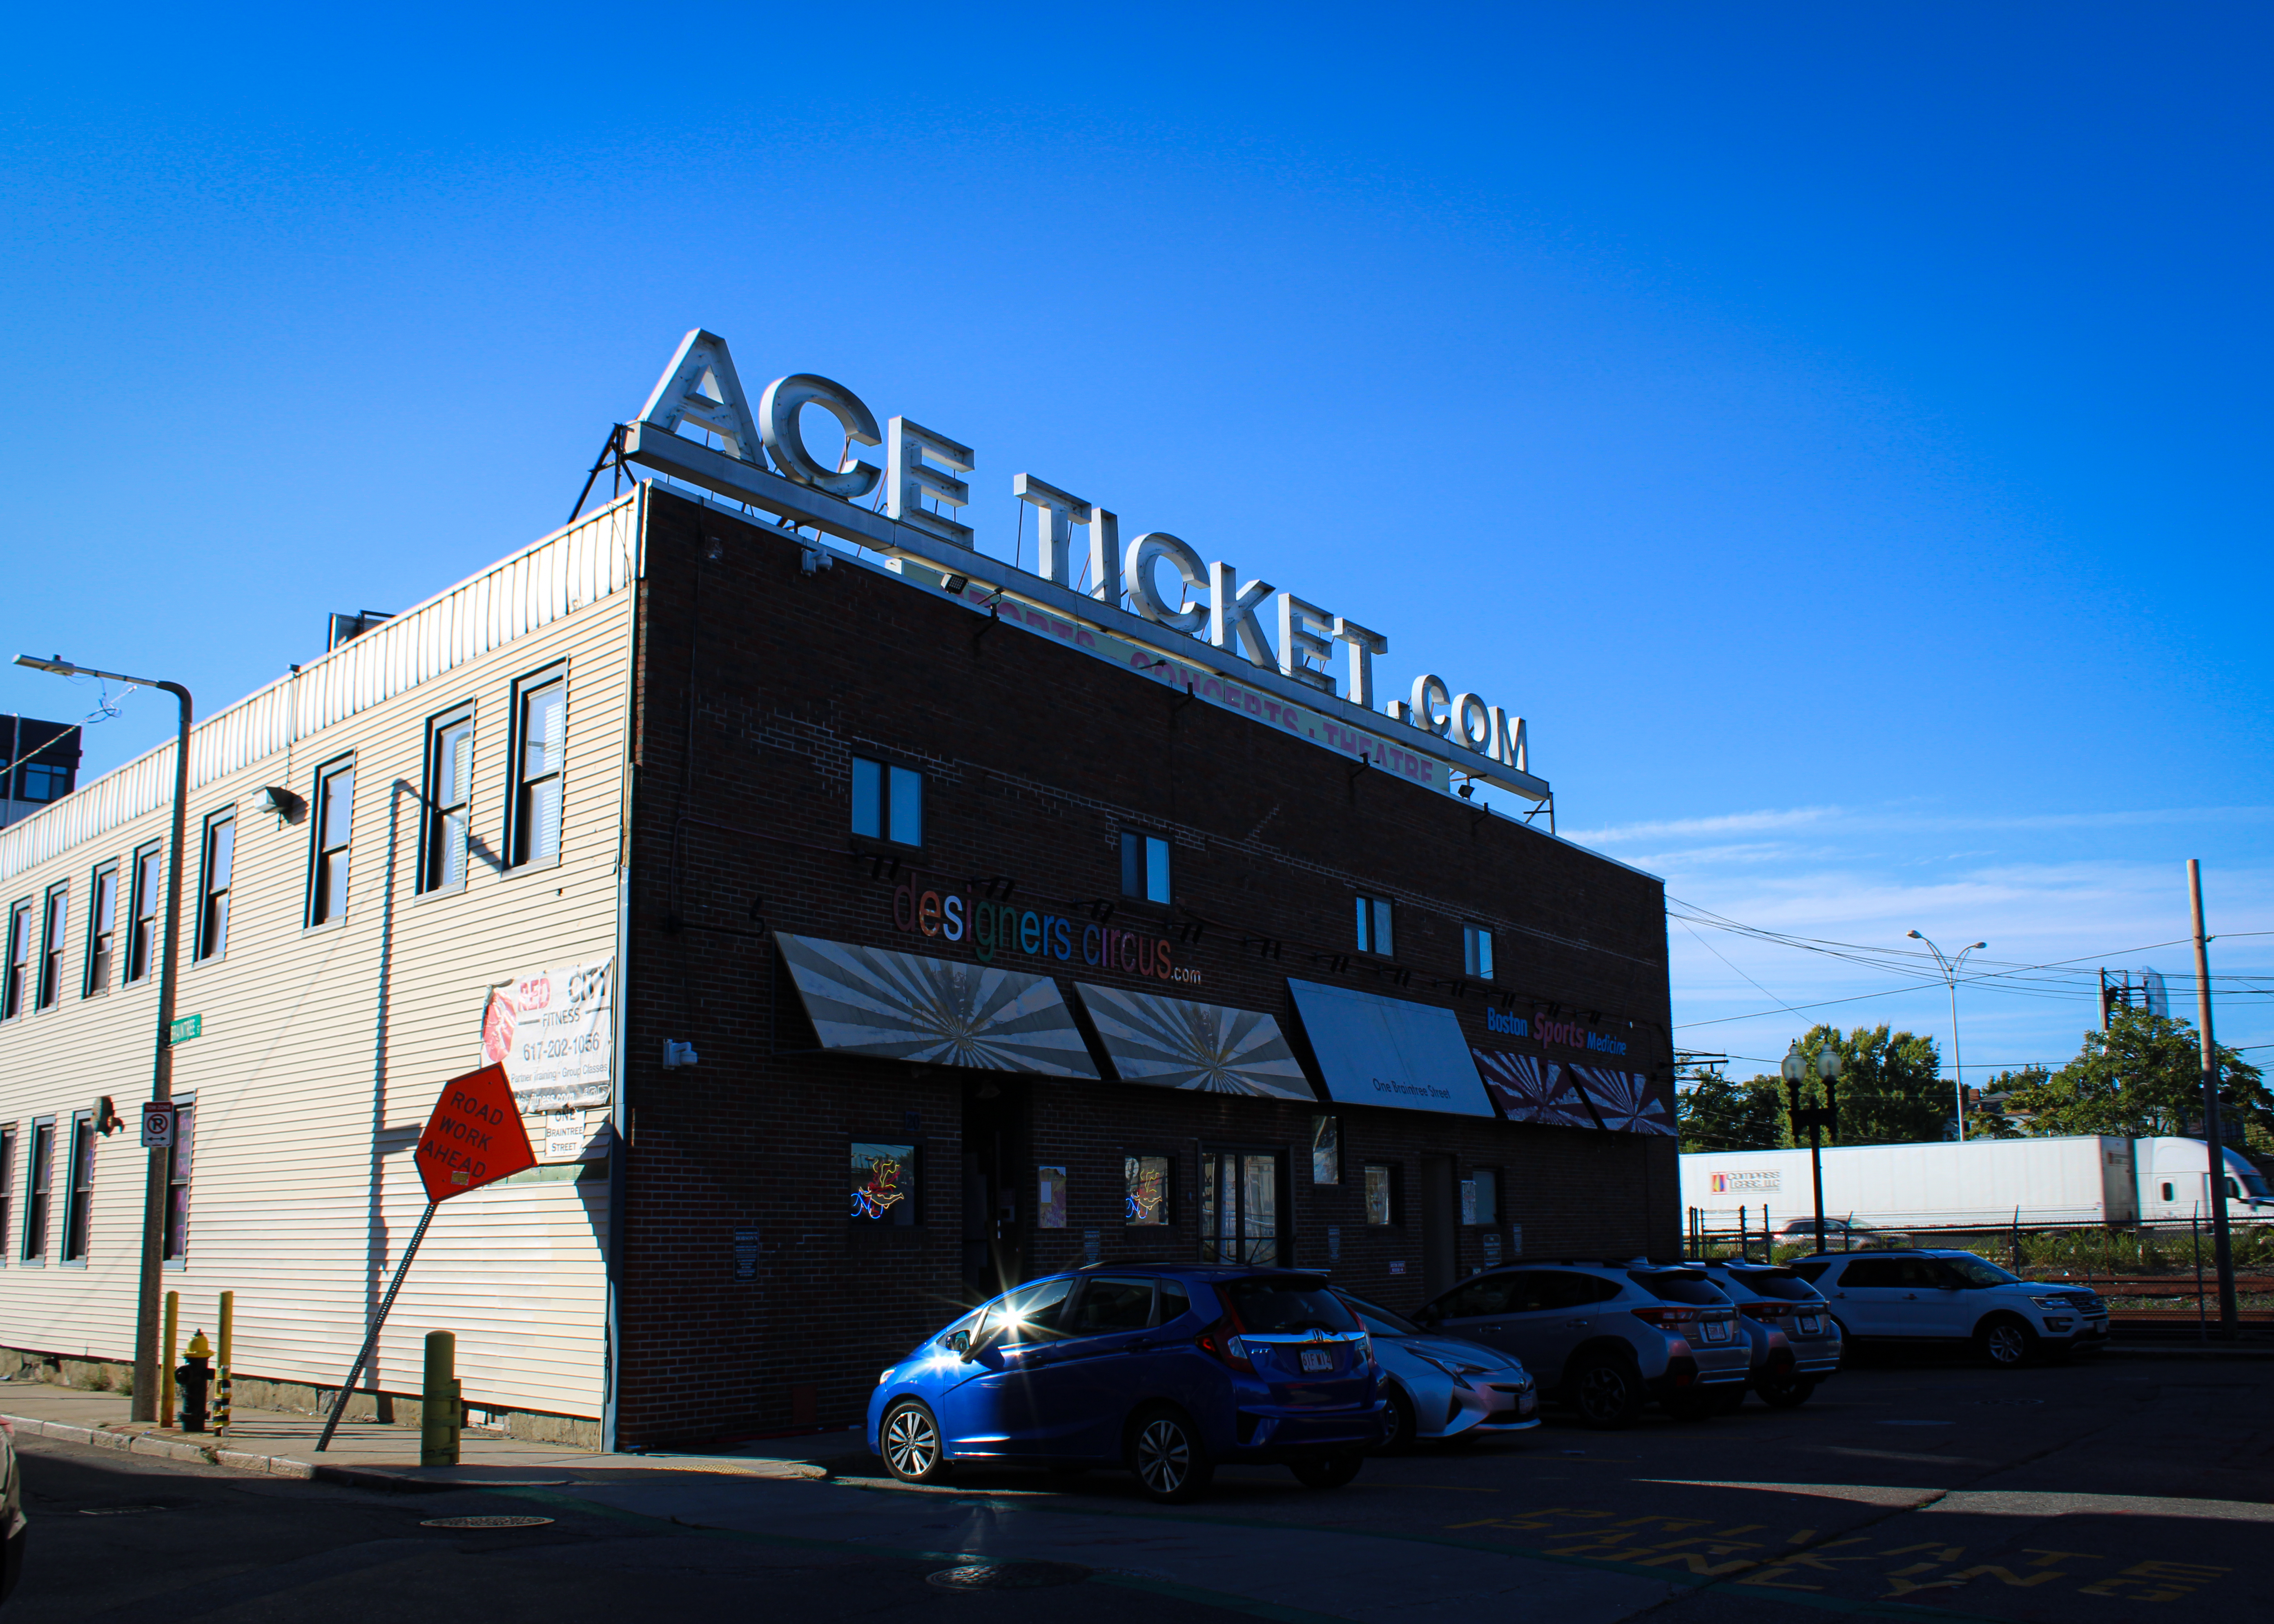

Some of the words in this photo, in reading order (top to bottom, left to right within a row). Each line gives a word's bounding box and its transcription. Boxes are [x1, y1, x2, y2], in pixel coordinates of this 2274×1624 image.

[636, 327, 975, 550] ACE
[893, 872, 1071, 962] designers
[517, 978, 551, 1012] RED
[568, 966, 606, 1003] CITY
[542, 1008, 580, 1027] FITNESS
[1487, 1007, 1528, 1037] Boston
[1533, 1012, 1584, 1049] Sports
[1587, 1031, 1626, 1056] Medicine
[523, 1031, 600, 1061] 617-202-1056
[511, 1073, 532, 1083] Partner
[533, 1069, 556, 1081] Training
[562, 1067, 581, 1078] Group
[583, 1063, 608, 1075] Classes
[1373, 1078, 1392, 1092] One
[1391, 1080, 1428, 1096] Braintree
[1428, 1085, 1451, 1099] Street
[450, 1091, 504, 1126] ROAD
[555, 1109, 576, 1122] ONE
[906, 1114, 920, 1130] 20
[438, 1115, 493, 1152] WORK
[419, 1139, 486, 1178] AHEAD
[1442, 1518, 2199, 1602] PARKING
[1511, 1508, 2234, 1583] PRIVATE
[1541, 1544, 1969, 1598] ONLY
